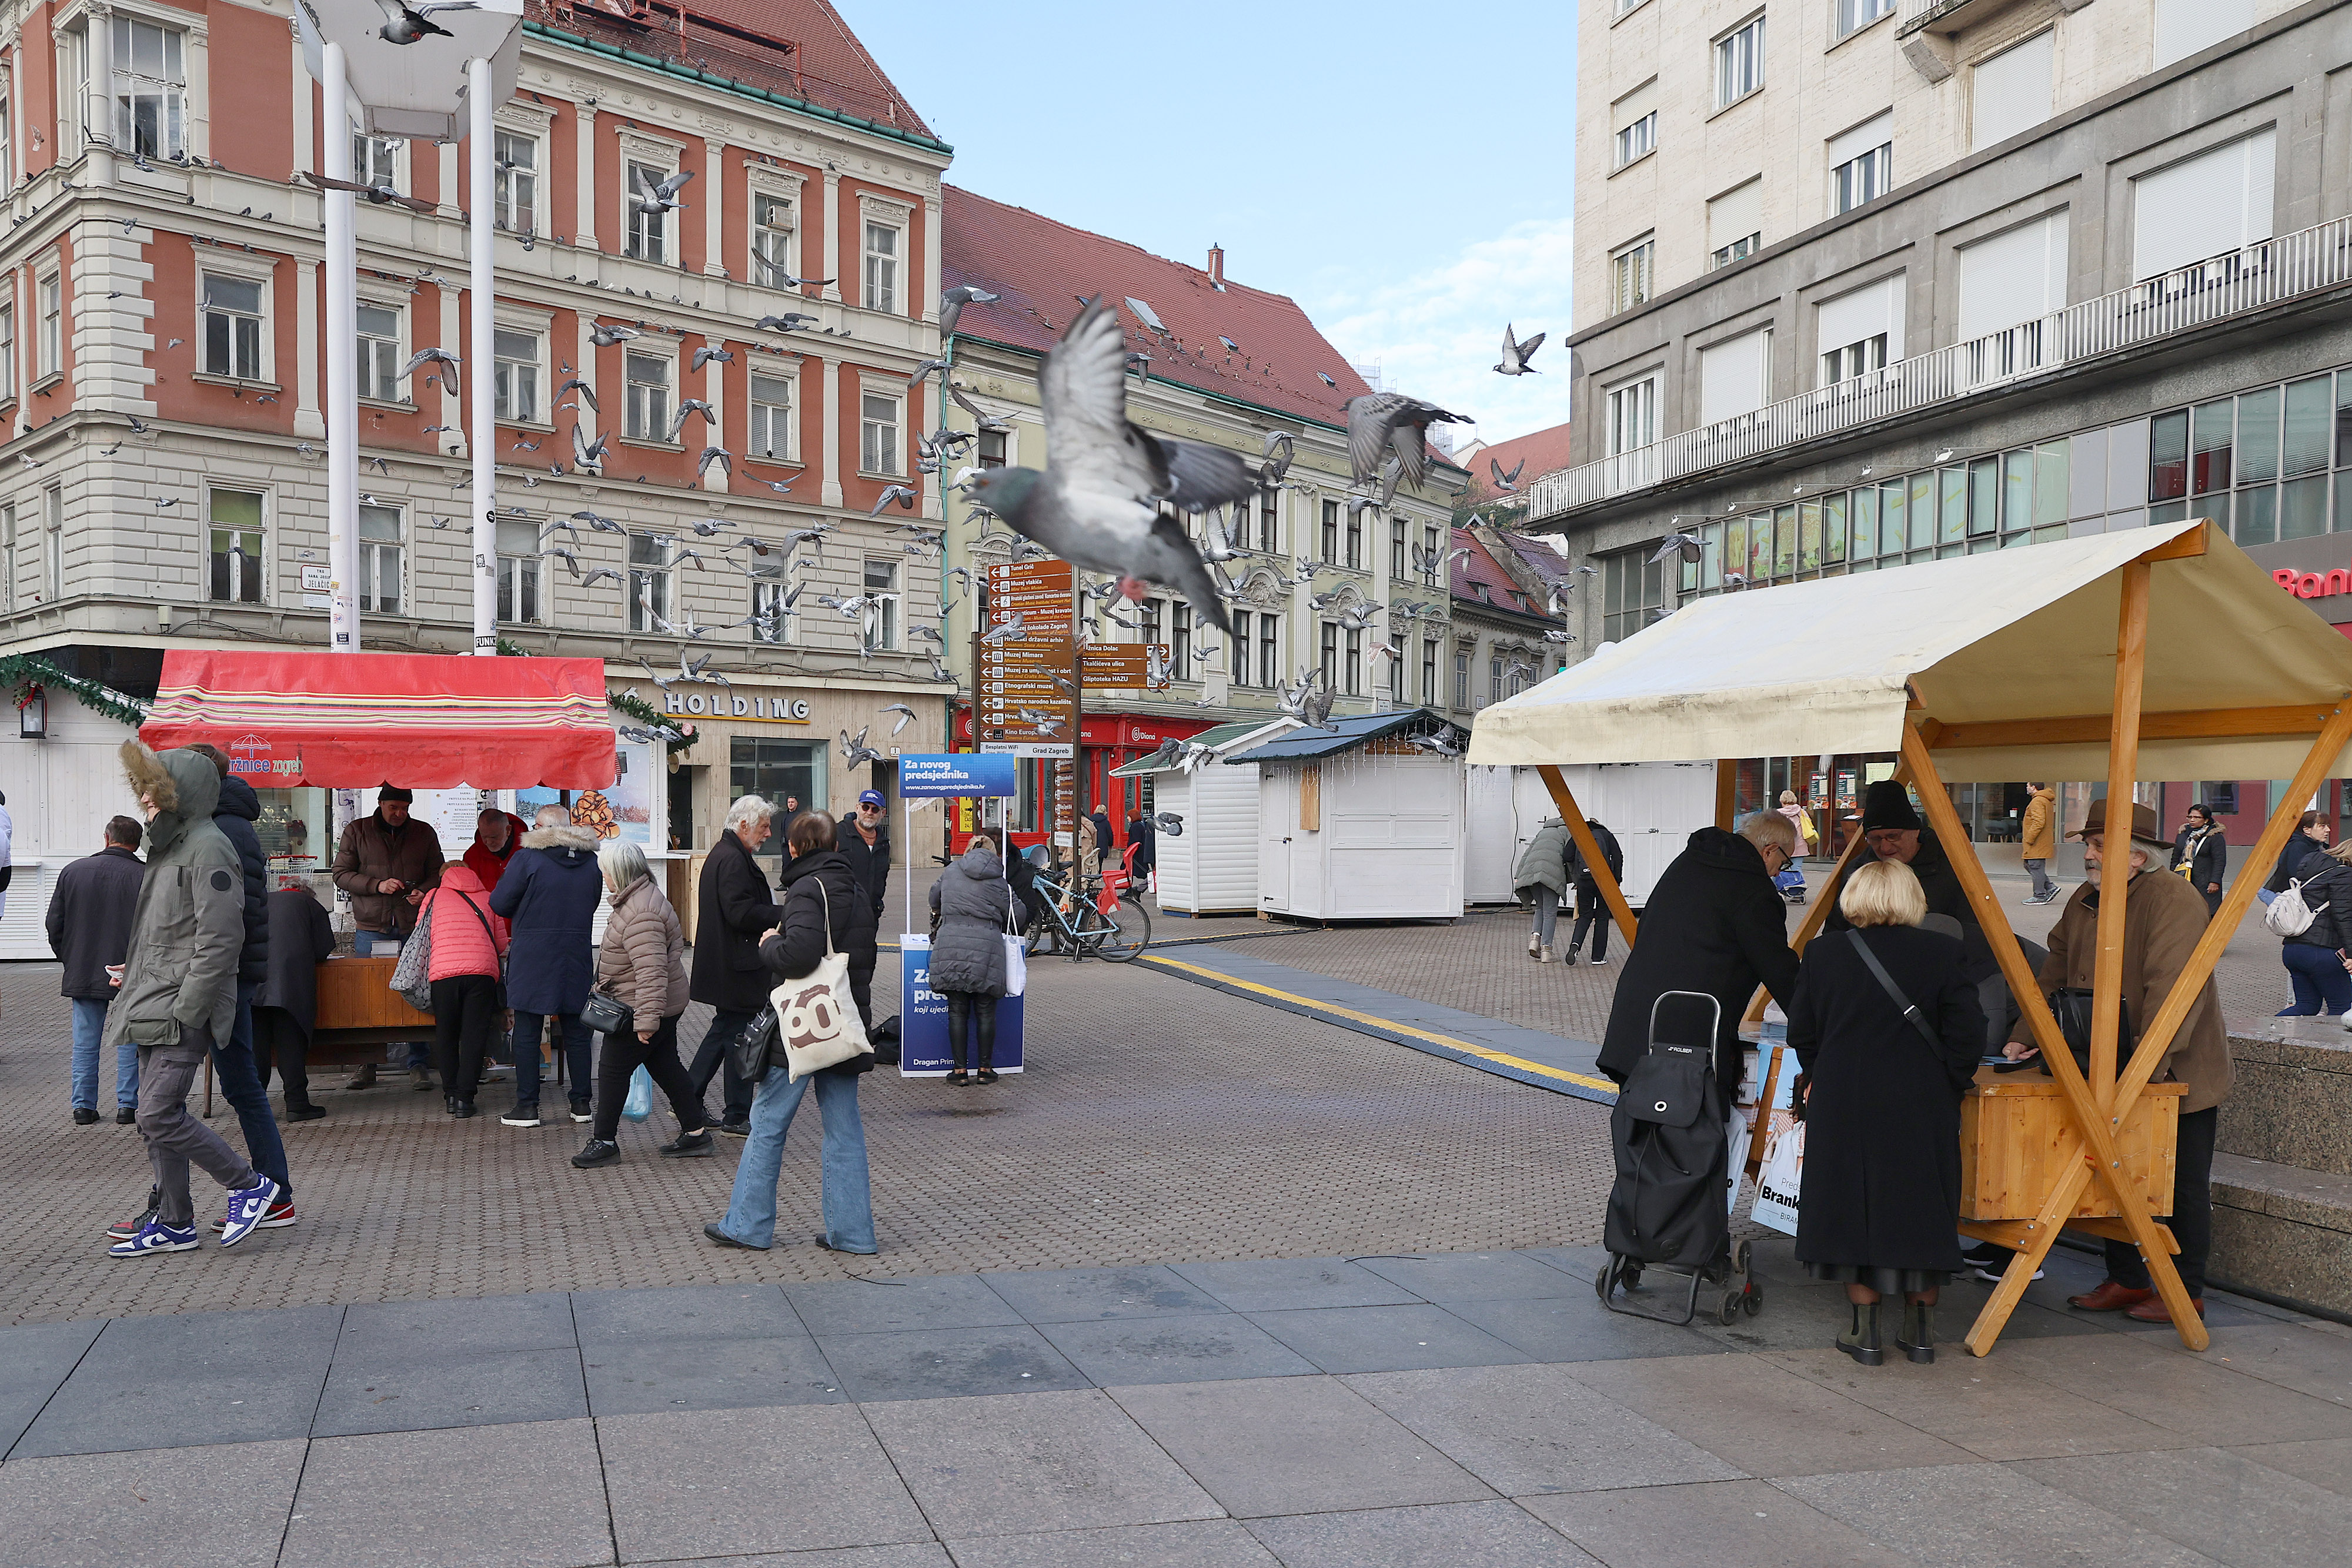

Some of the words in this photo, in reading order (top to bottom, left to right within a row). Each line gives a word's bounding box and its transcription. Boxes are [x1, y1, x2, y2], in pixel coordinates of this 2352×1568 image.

[2272, 560, 2352, 599] Ban
[664, 693, 810, 719] HOLDING
[272, 756, 303, 777] zagreb
[904, 760, 917, 769] Za
[920, 761, 951, 771] novog
[905, 770, 969, 781] predsjednika
[914, 1005, 928, 1014] koji
